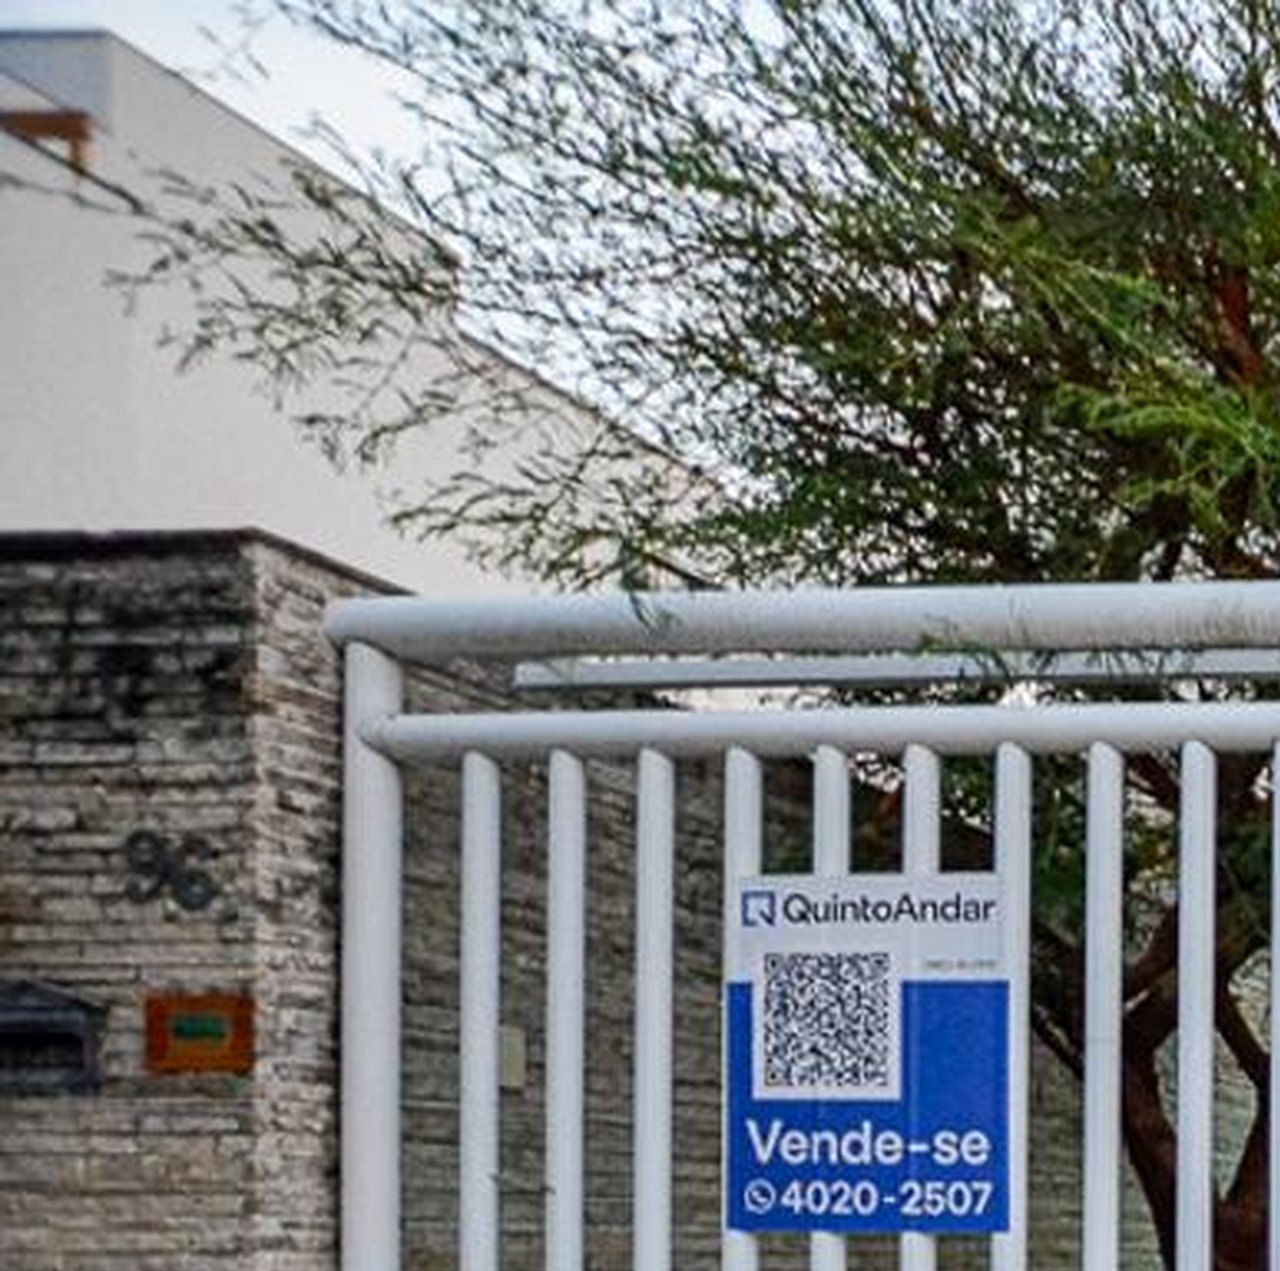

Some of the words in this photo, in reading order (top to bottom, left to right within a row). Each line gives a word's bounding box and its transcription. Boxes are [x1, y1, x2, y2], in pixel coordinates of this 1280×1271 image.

[782, 892, 996, 926] QuintoAndar
[746, 1118, 990, 1166] Vende-se
[780, 1180, 993, 1216] 4020-2507
